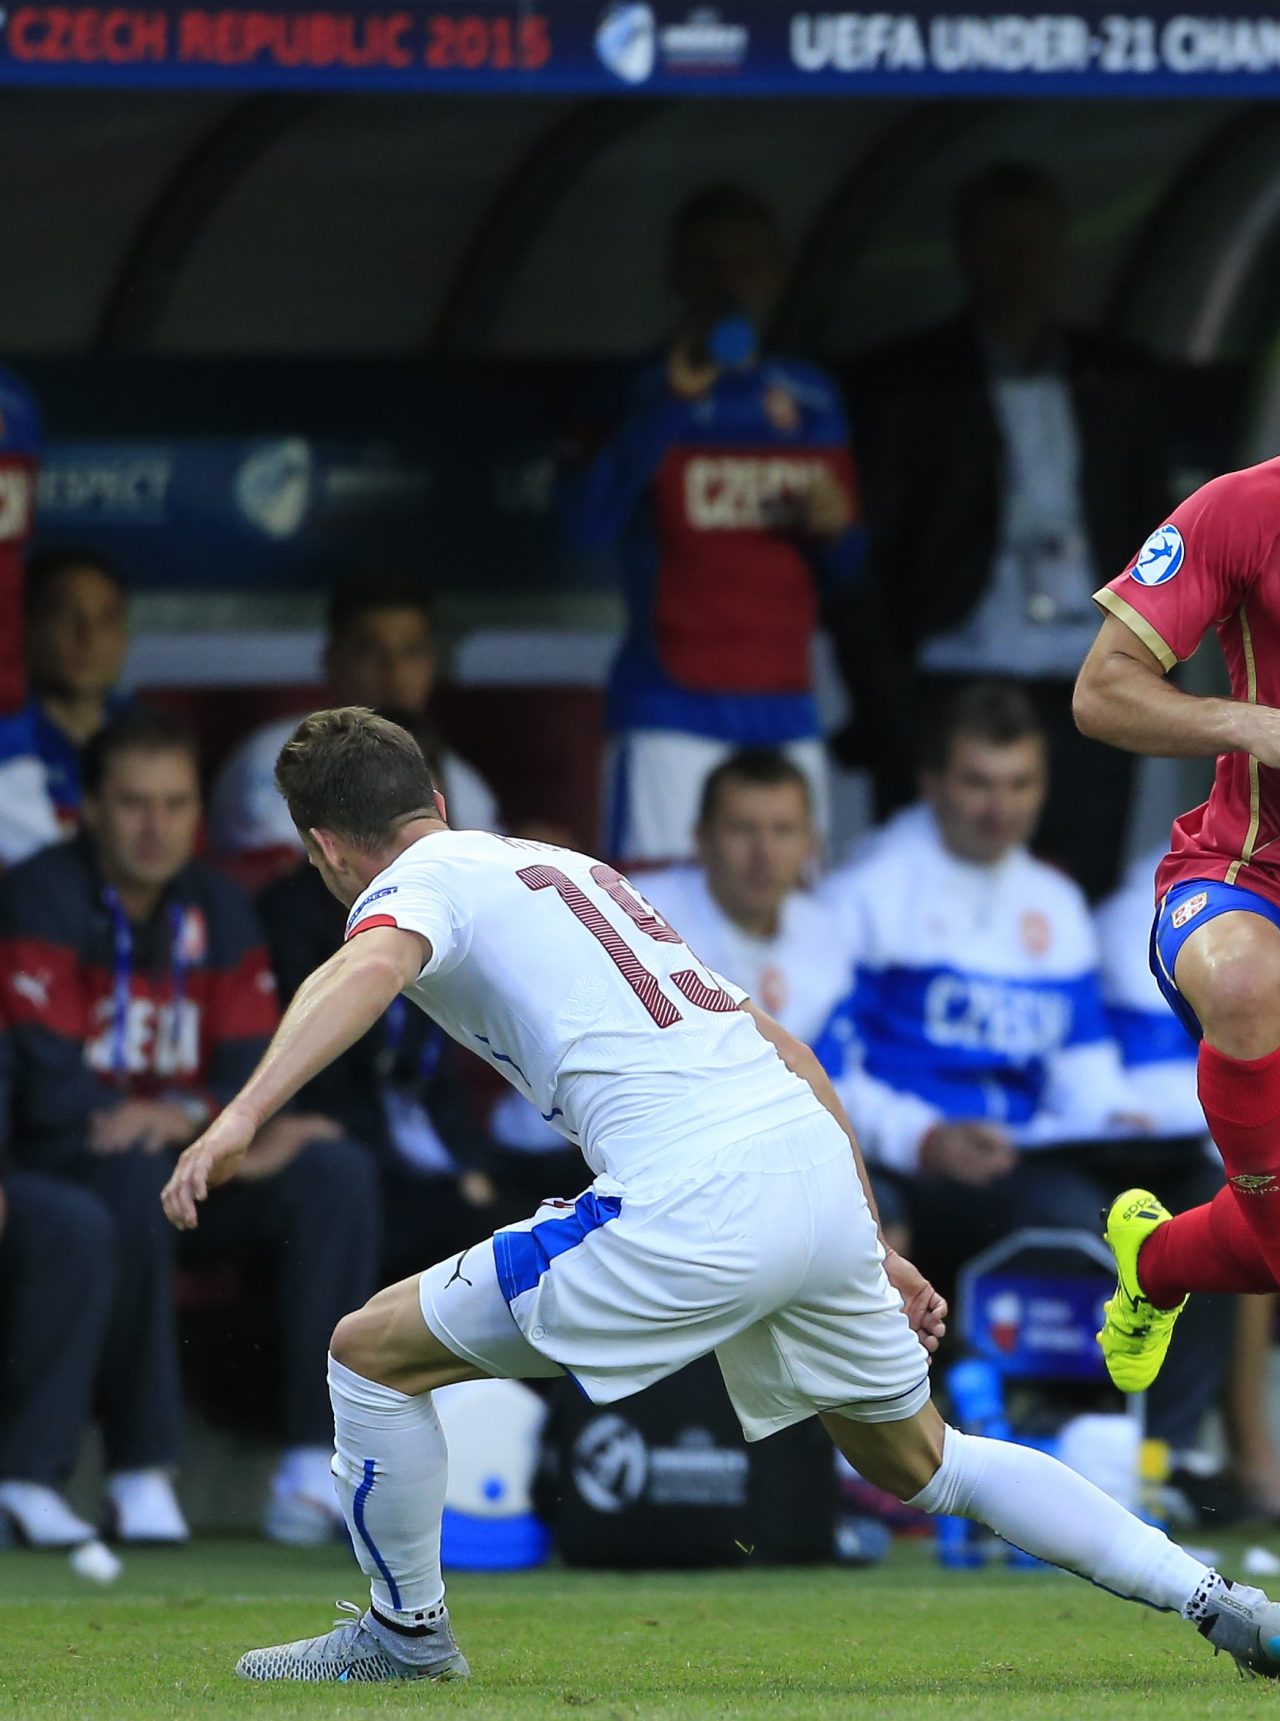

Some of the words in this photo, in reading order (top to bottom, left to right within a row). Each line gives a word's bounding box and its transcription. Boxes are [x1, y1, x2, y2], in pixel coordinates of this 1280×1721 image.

[8, 8, 167, 63] CZECH
[178, 8, 413, 67] REPUBLIC
[425, 12, 552, 69] 2015
[790, 14, 926, 71] UEFA
[930, 15, 1159, 73] UNDER-21
[38, 461, 172, 513] ESPECT
[515, 863, 741, 1030] 19
